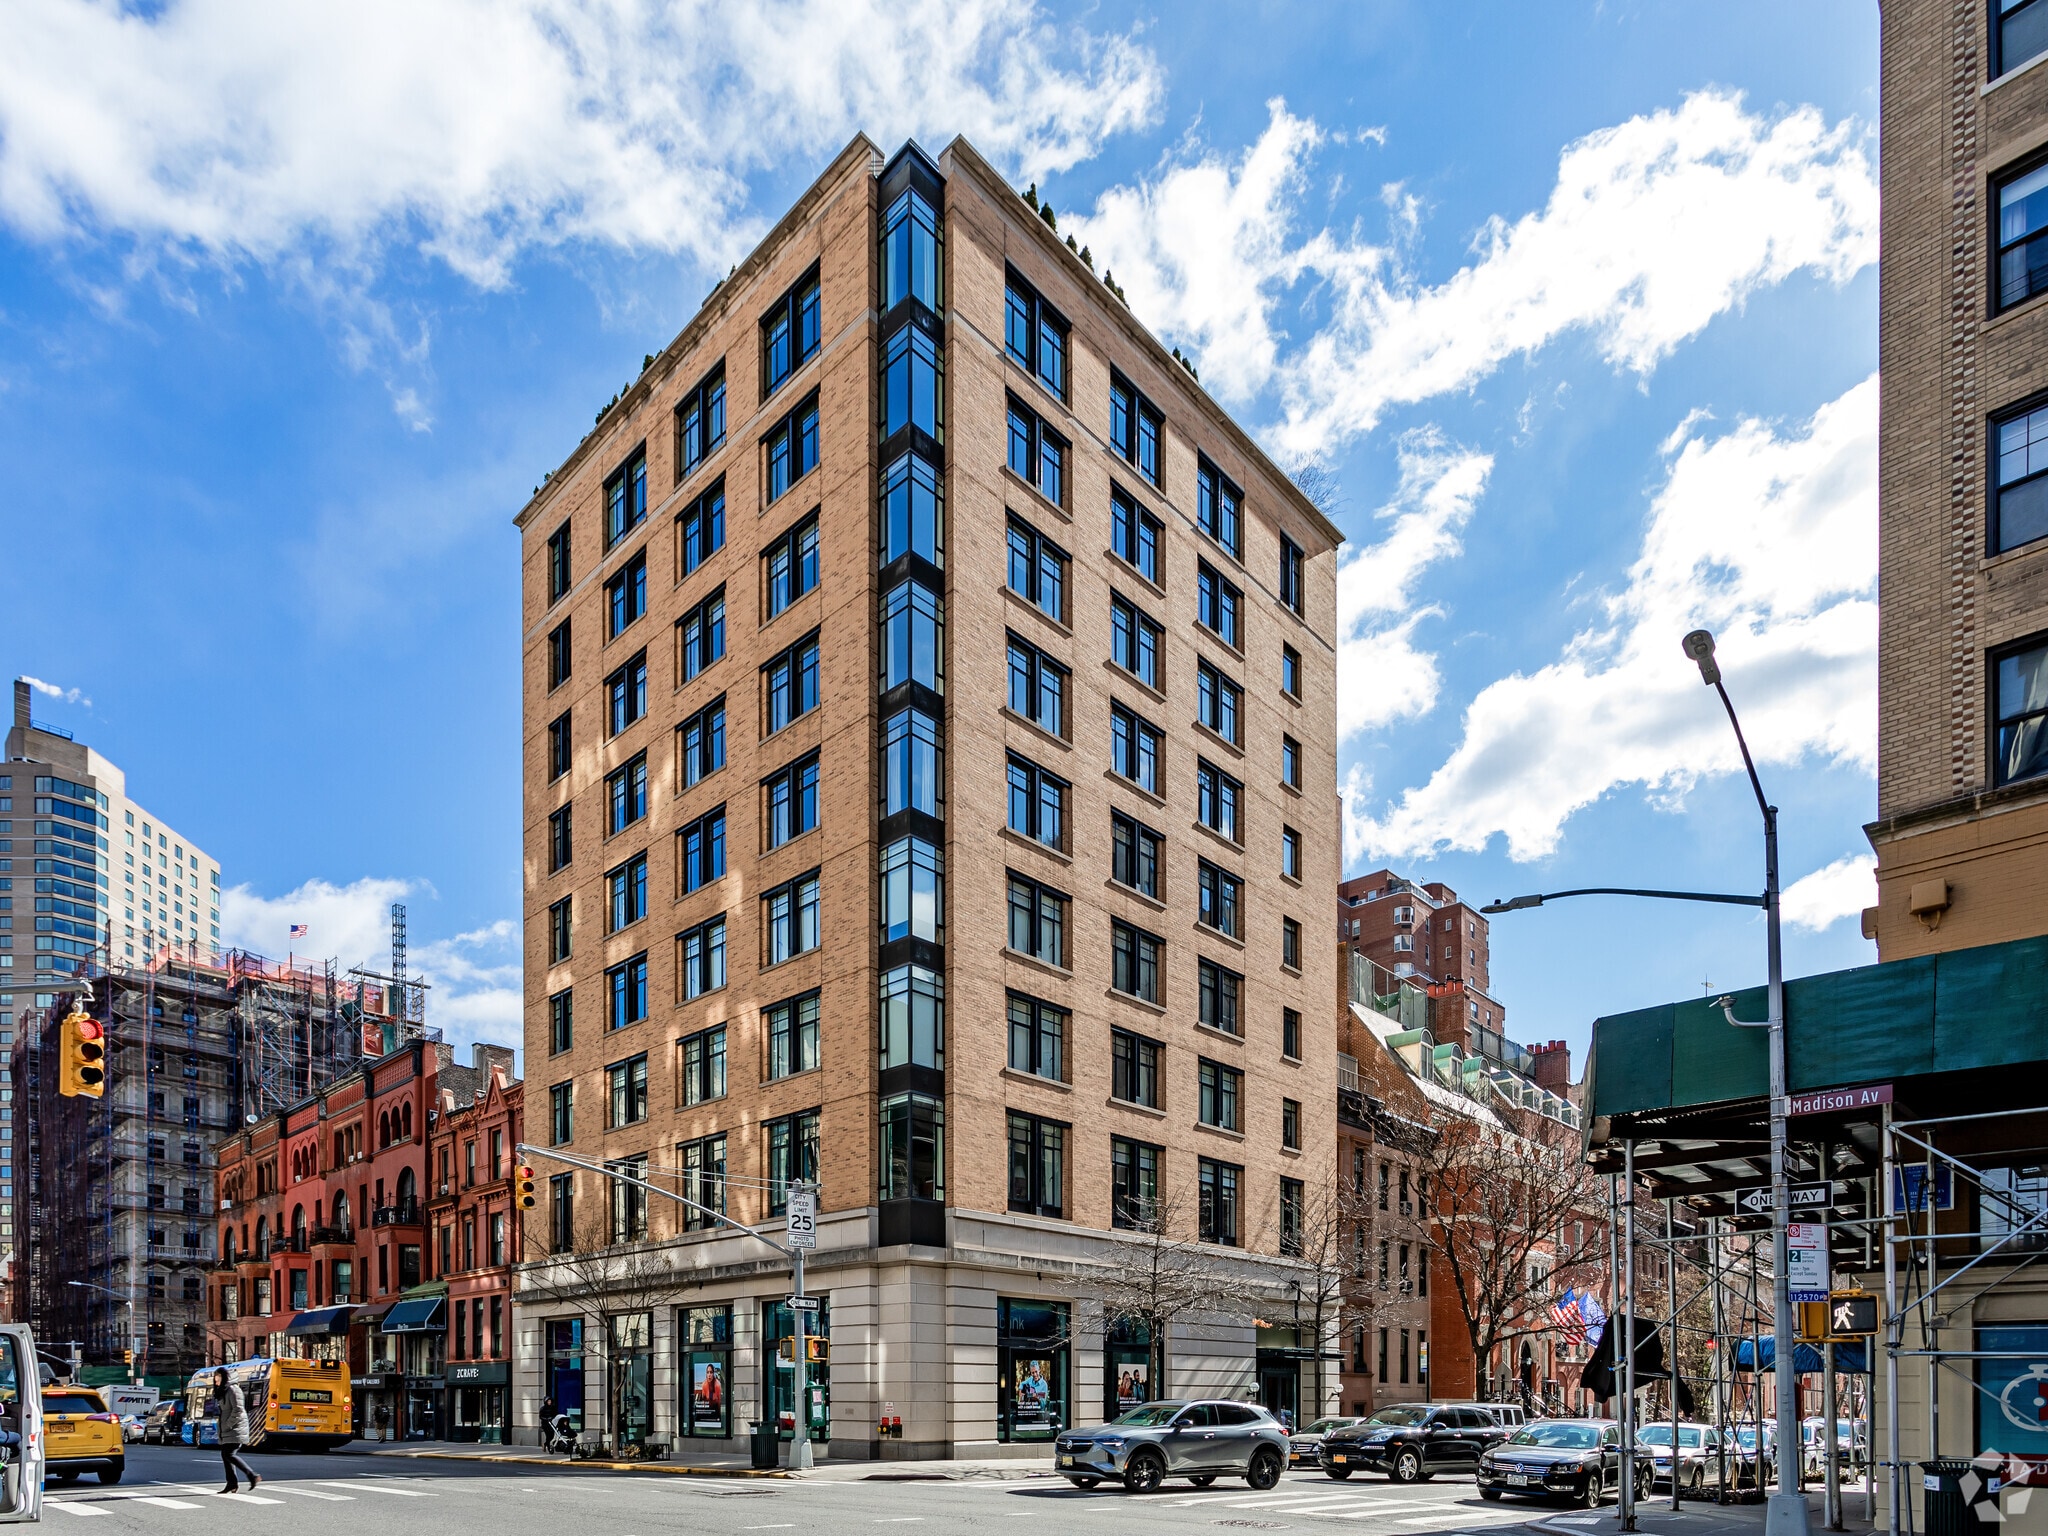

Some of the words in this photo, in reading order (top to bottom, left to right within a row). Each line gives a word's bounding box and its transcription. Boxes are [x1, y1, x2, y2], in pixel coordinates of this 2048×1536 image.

[1792, 1095, 1853, 1113] Madison
[1861, 1090, 1879, 1104] Av
[1750, 1194, 1773, 1206] ONE
[1789, 1190, 1819, 1202] WAY
[791, 1214, 812, 1231] 25
[1791, 1251, 1798, 1261] 2
[1790, 1293, 1819, 1301] 112570
